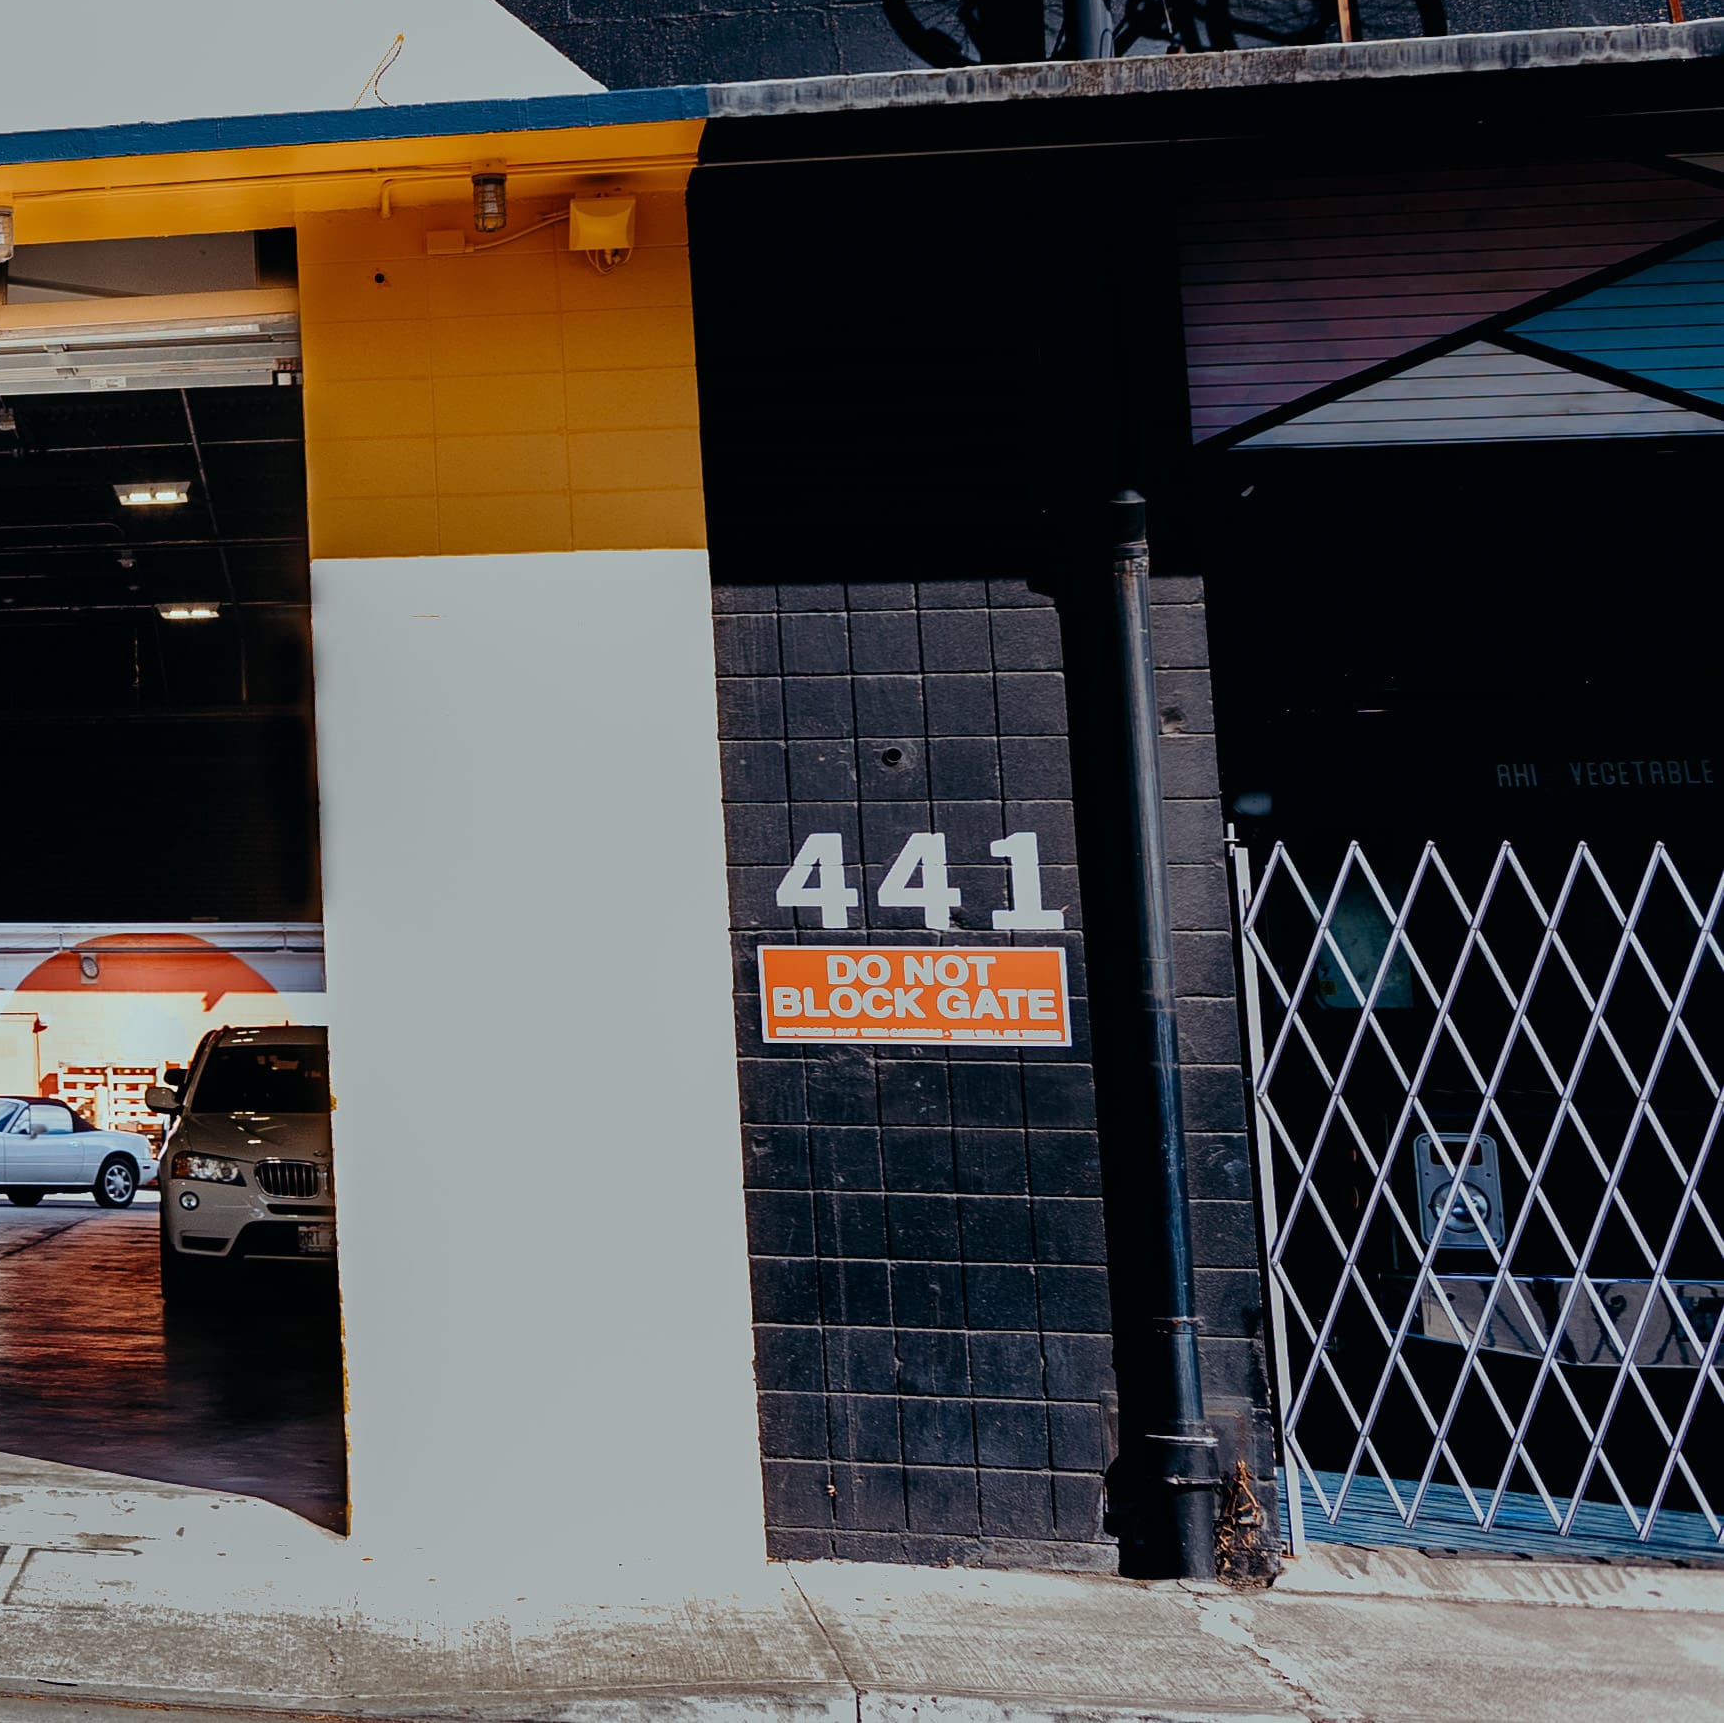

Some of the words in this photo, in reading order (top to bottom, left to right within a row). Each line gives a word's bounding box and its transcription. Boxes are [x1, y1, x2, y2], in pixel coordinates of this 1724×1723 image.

[1496, 763, 1537, 787] AHI
[1568, 759, 1714, 786] VEGETABLE
[776, 832, 1065, 930] 441
[826, 954, 891, 986] DO
[903, 954, 996, 987] NOT
[772, 986, 926, 1018] BLOCK
[936, 987, 1057, 1021] GATE
